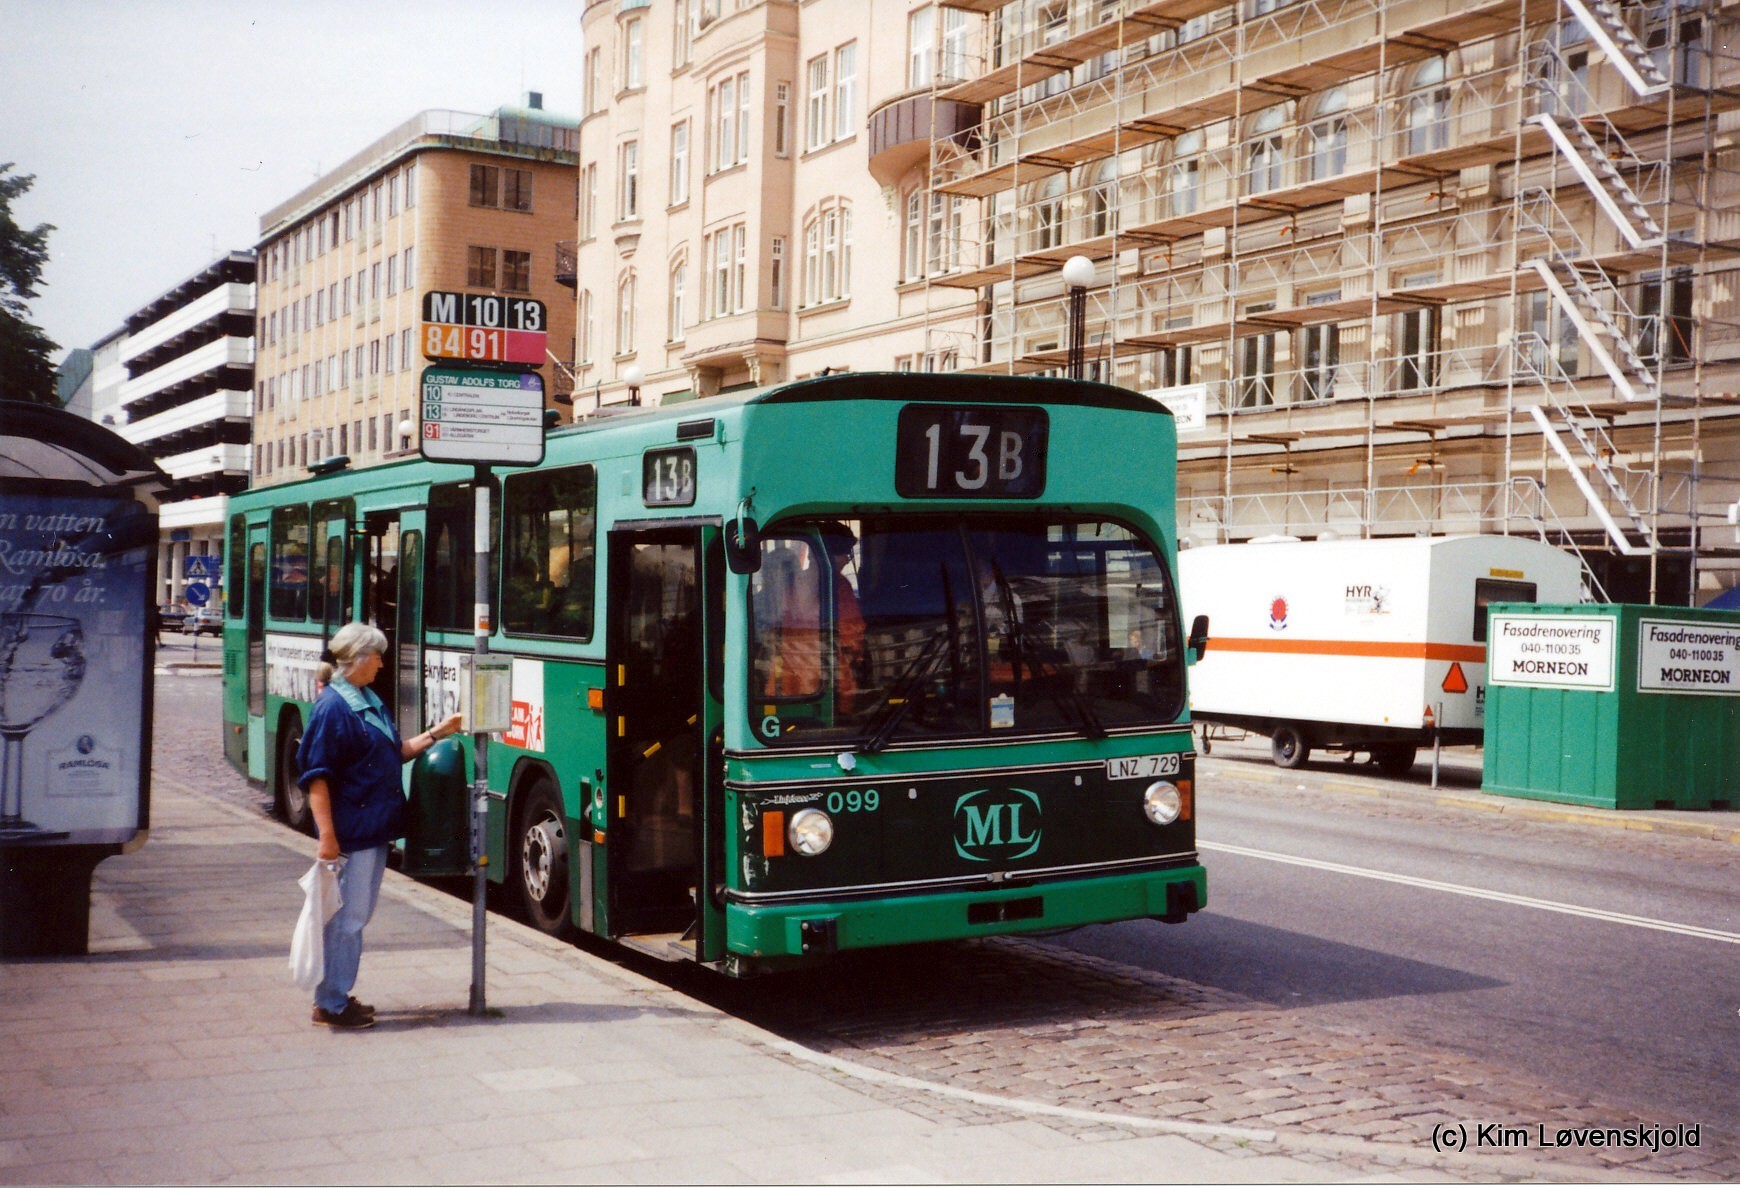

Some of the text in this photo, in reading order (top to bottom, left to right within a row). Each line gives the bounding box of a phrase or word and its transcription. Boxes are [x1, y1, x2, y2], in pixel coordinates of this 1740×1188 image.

[430, 292, 541, 331] M 10 13
[426, 325, 499, 360] 84 91
[426, 374, 521, 389] GUSTAV ADOLFS TORG
[427, 386, 442, 401] 10
[427, 404, 441, 419] 13
[426, 423, 440, 438] 91
[25, 513, 105, 533] vatten
[1345, 585, 1372, 598] HYR
[1503, 622, 1601, 644] Fasadrenovering
[1650, 626, 1740, 651] Fasadrenovering
[1521, 643, 1581, 655] 040-110035
[1669, 648, 1725, 661] 040-110035
[425, 658, 456, 684] ekrytera
[1512, 660, 1588, 676] MORNEON
[1661, 667, 1731, 684] MORNEON
[760, 715, 780, 738] G
[1107, 756, 1179, 779] LNZ 729
[827, 789, 880, 814] 099
[963, 802, 1036, 847] ML
